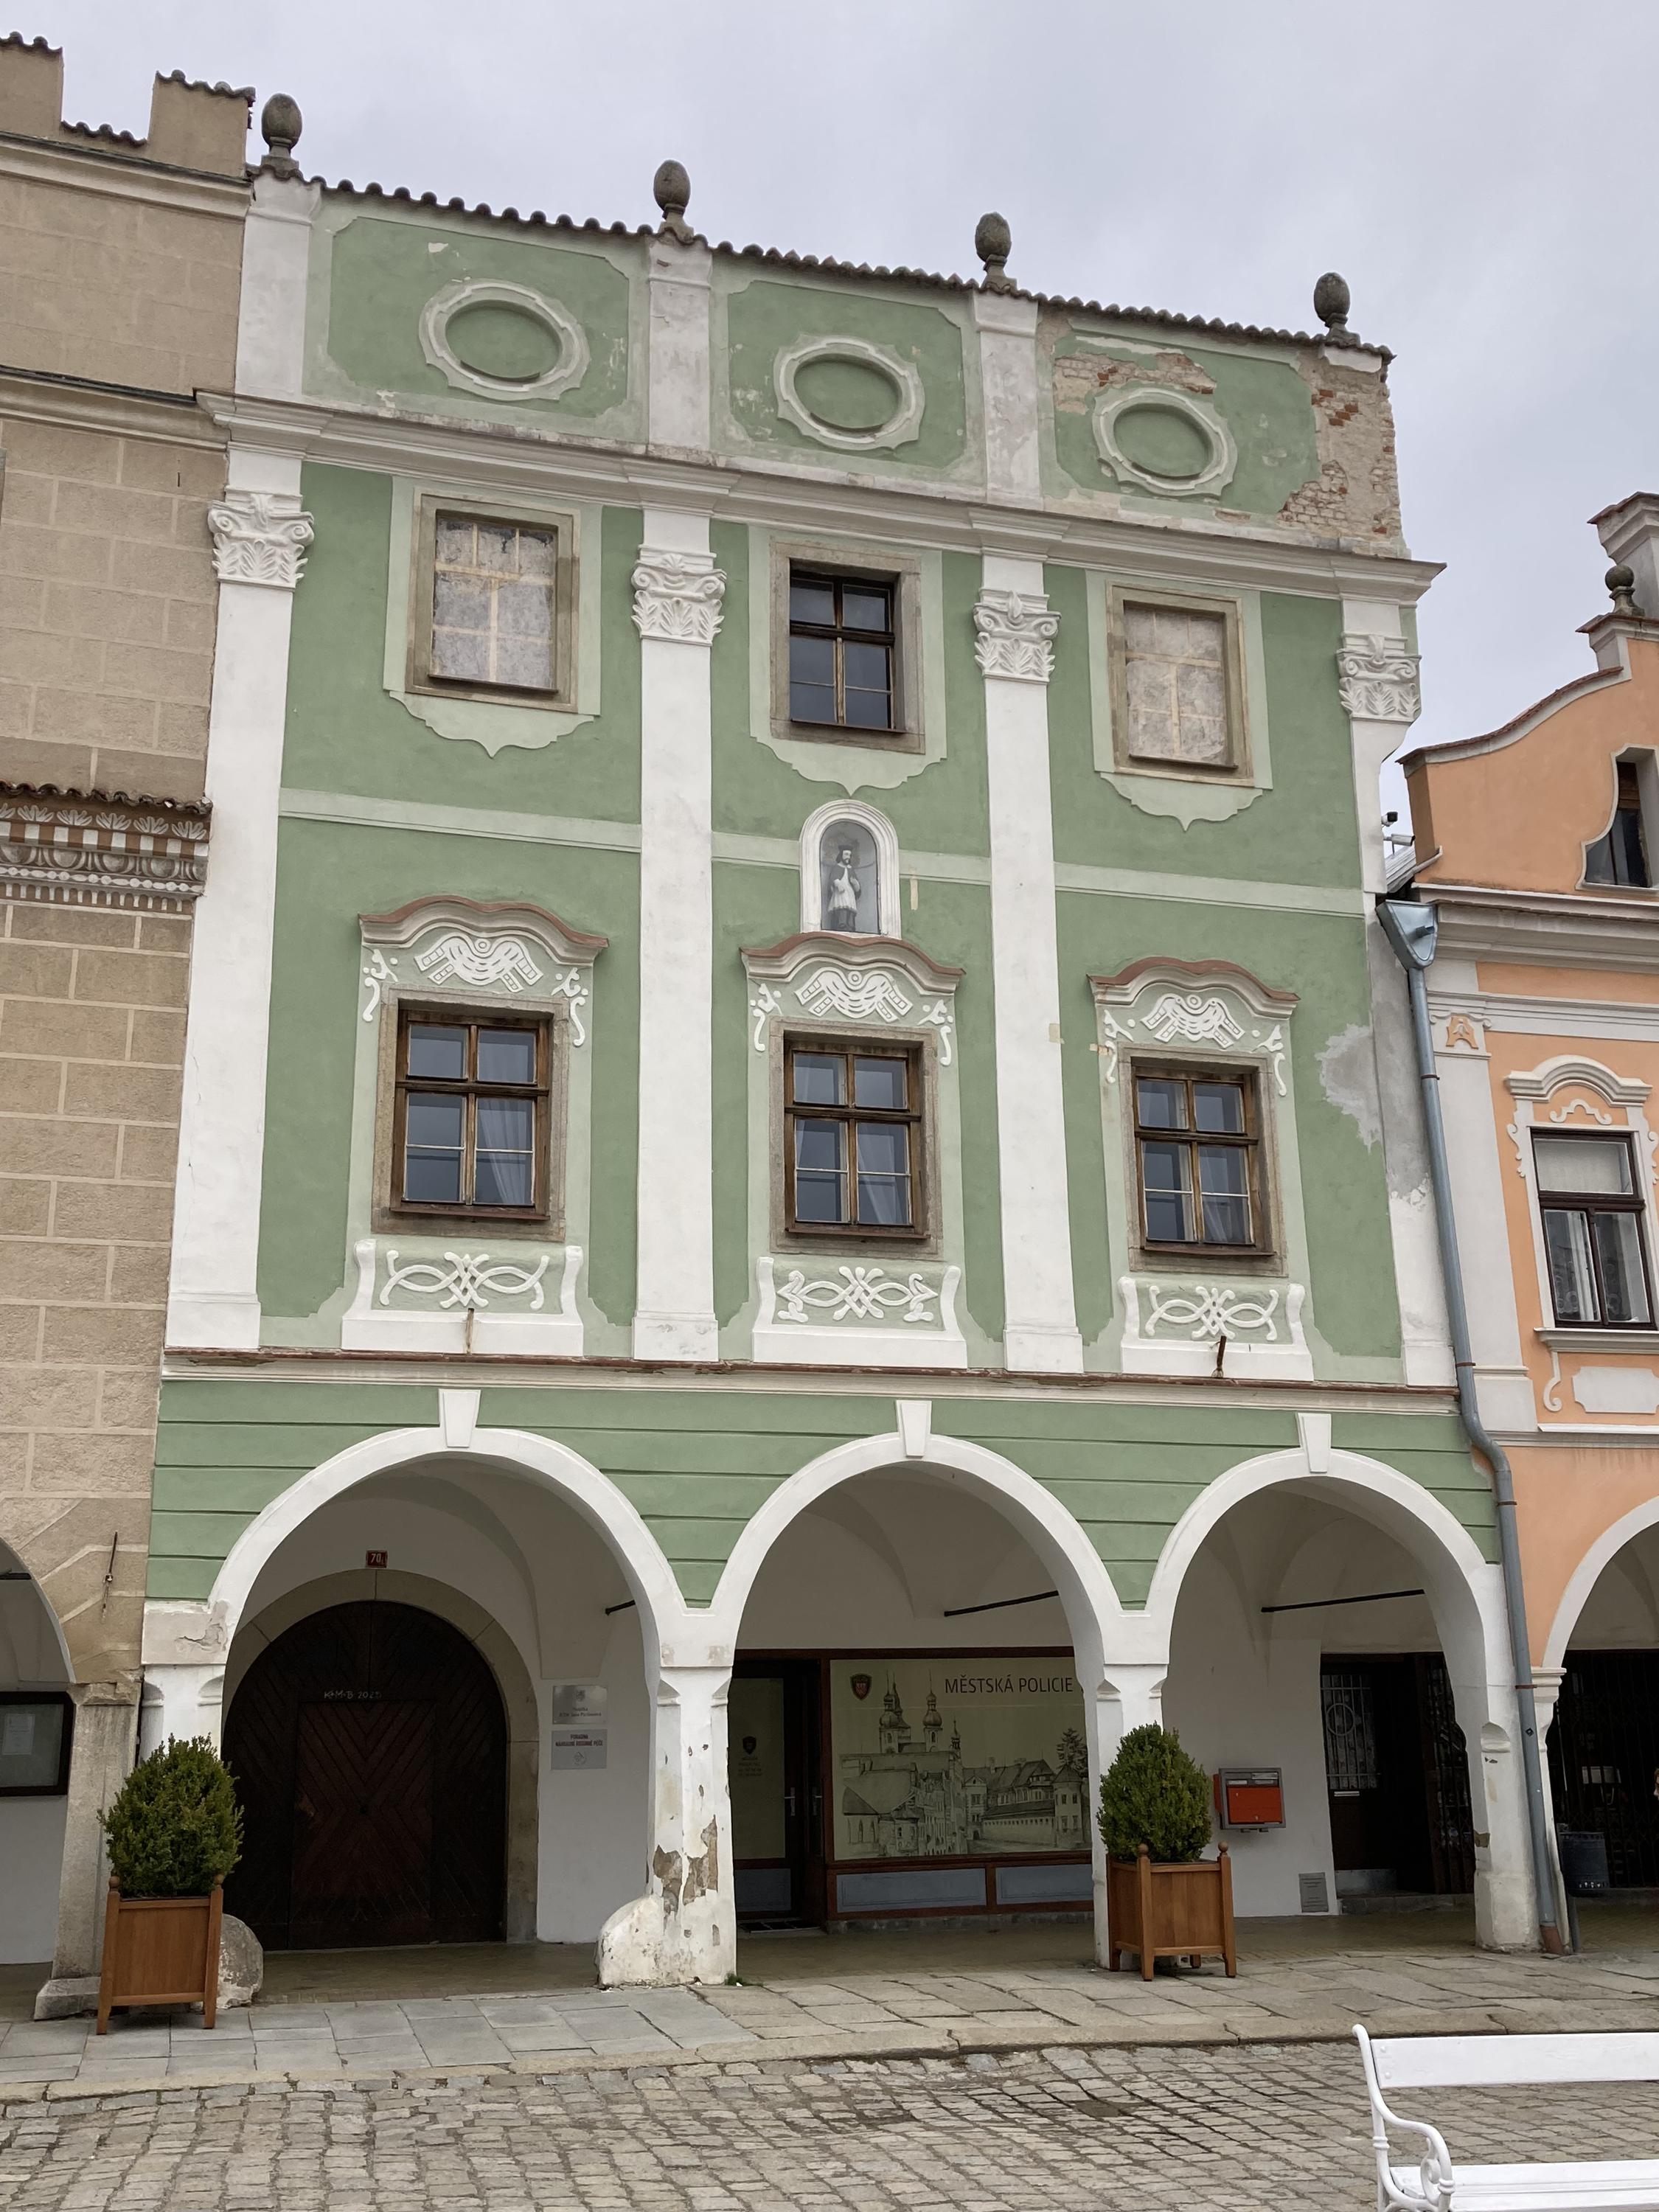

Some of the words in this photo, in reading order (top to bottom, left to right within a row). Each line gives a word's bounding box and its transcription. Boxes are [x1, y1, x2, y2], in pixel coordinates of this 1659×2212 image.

[371, 1553, 381, 1563] 70
[945, 1674, 1013, 1693] MĚSTSKÁ
[1019, 1677, 1074, 1692] POLICIE
